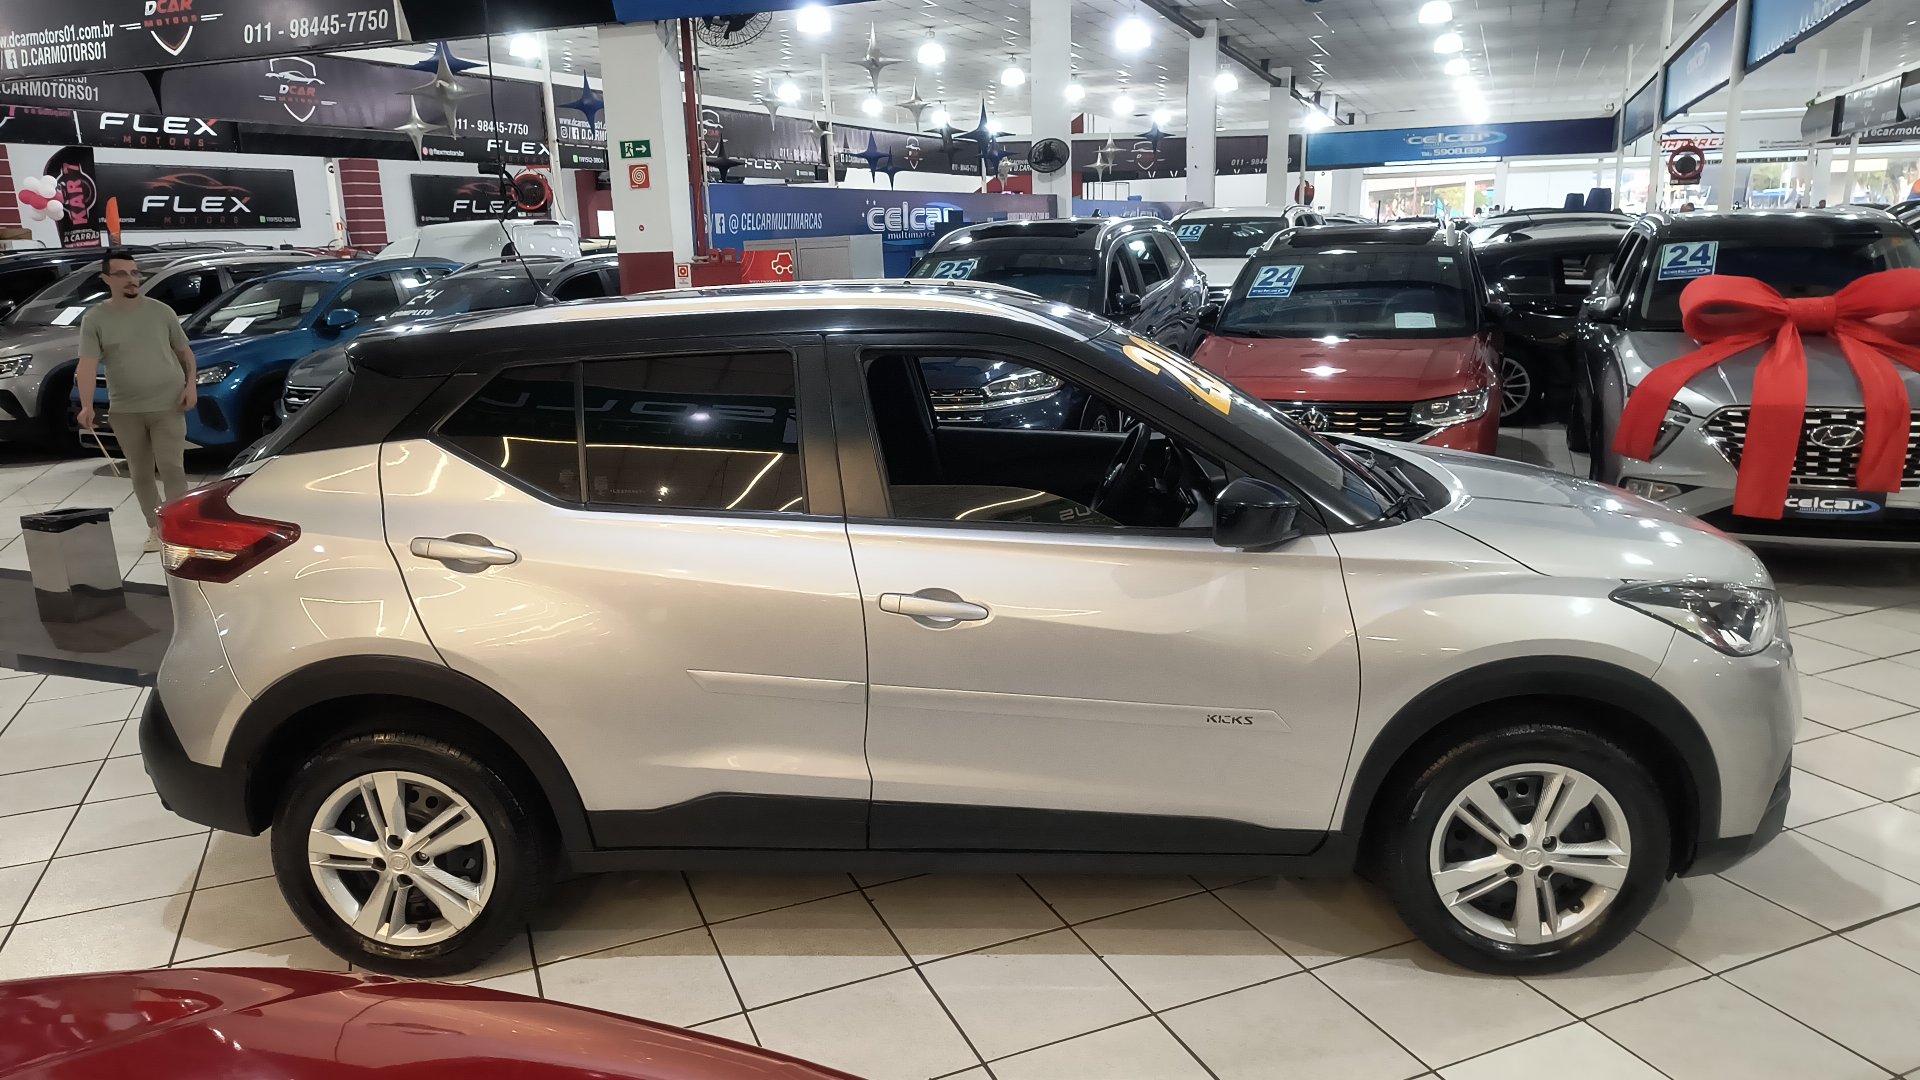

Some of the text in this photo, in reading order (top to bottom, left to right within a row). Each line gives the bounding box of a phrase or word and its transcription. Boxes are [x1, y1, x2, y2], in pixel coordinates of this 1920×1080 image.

[145, 0, 192, 16] DCAR
[144, 15, 198, 27] MOTORS
[244, 22, 271, 43] 011
[289, 8, 389, 39] 98445-7750
[21, 41, 107, 67] D.CARMOTORS01
[279, 84, 316, 97] DCAR
[100, 112, 218, 136] FLEX
[123, 135, 205, 147] MOTORS
[142, 196, 251, 213] FLEX
[741, 212, 823, 231] CELCARMULTIMARCAS
[866, 201, 953, 232] celcar
[1181, 226, 1202, 236] 18
[1667, 243, 1711, 267] 24
[935, 262, 973, 279] 25
[1257, 267, 1297, 286] 24
[1784, 496, 1864, 510] celcar
[1206, 714, 1254, 725] KICKS
